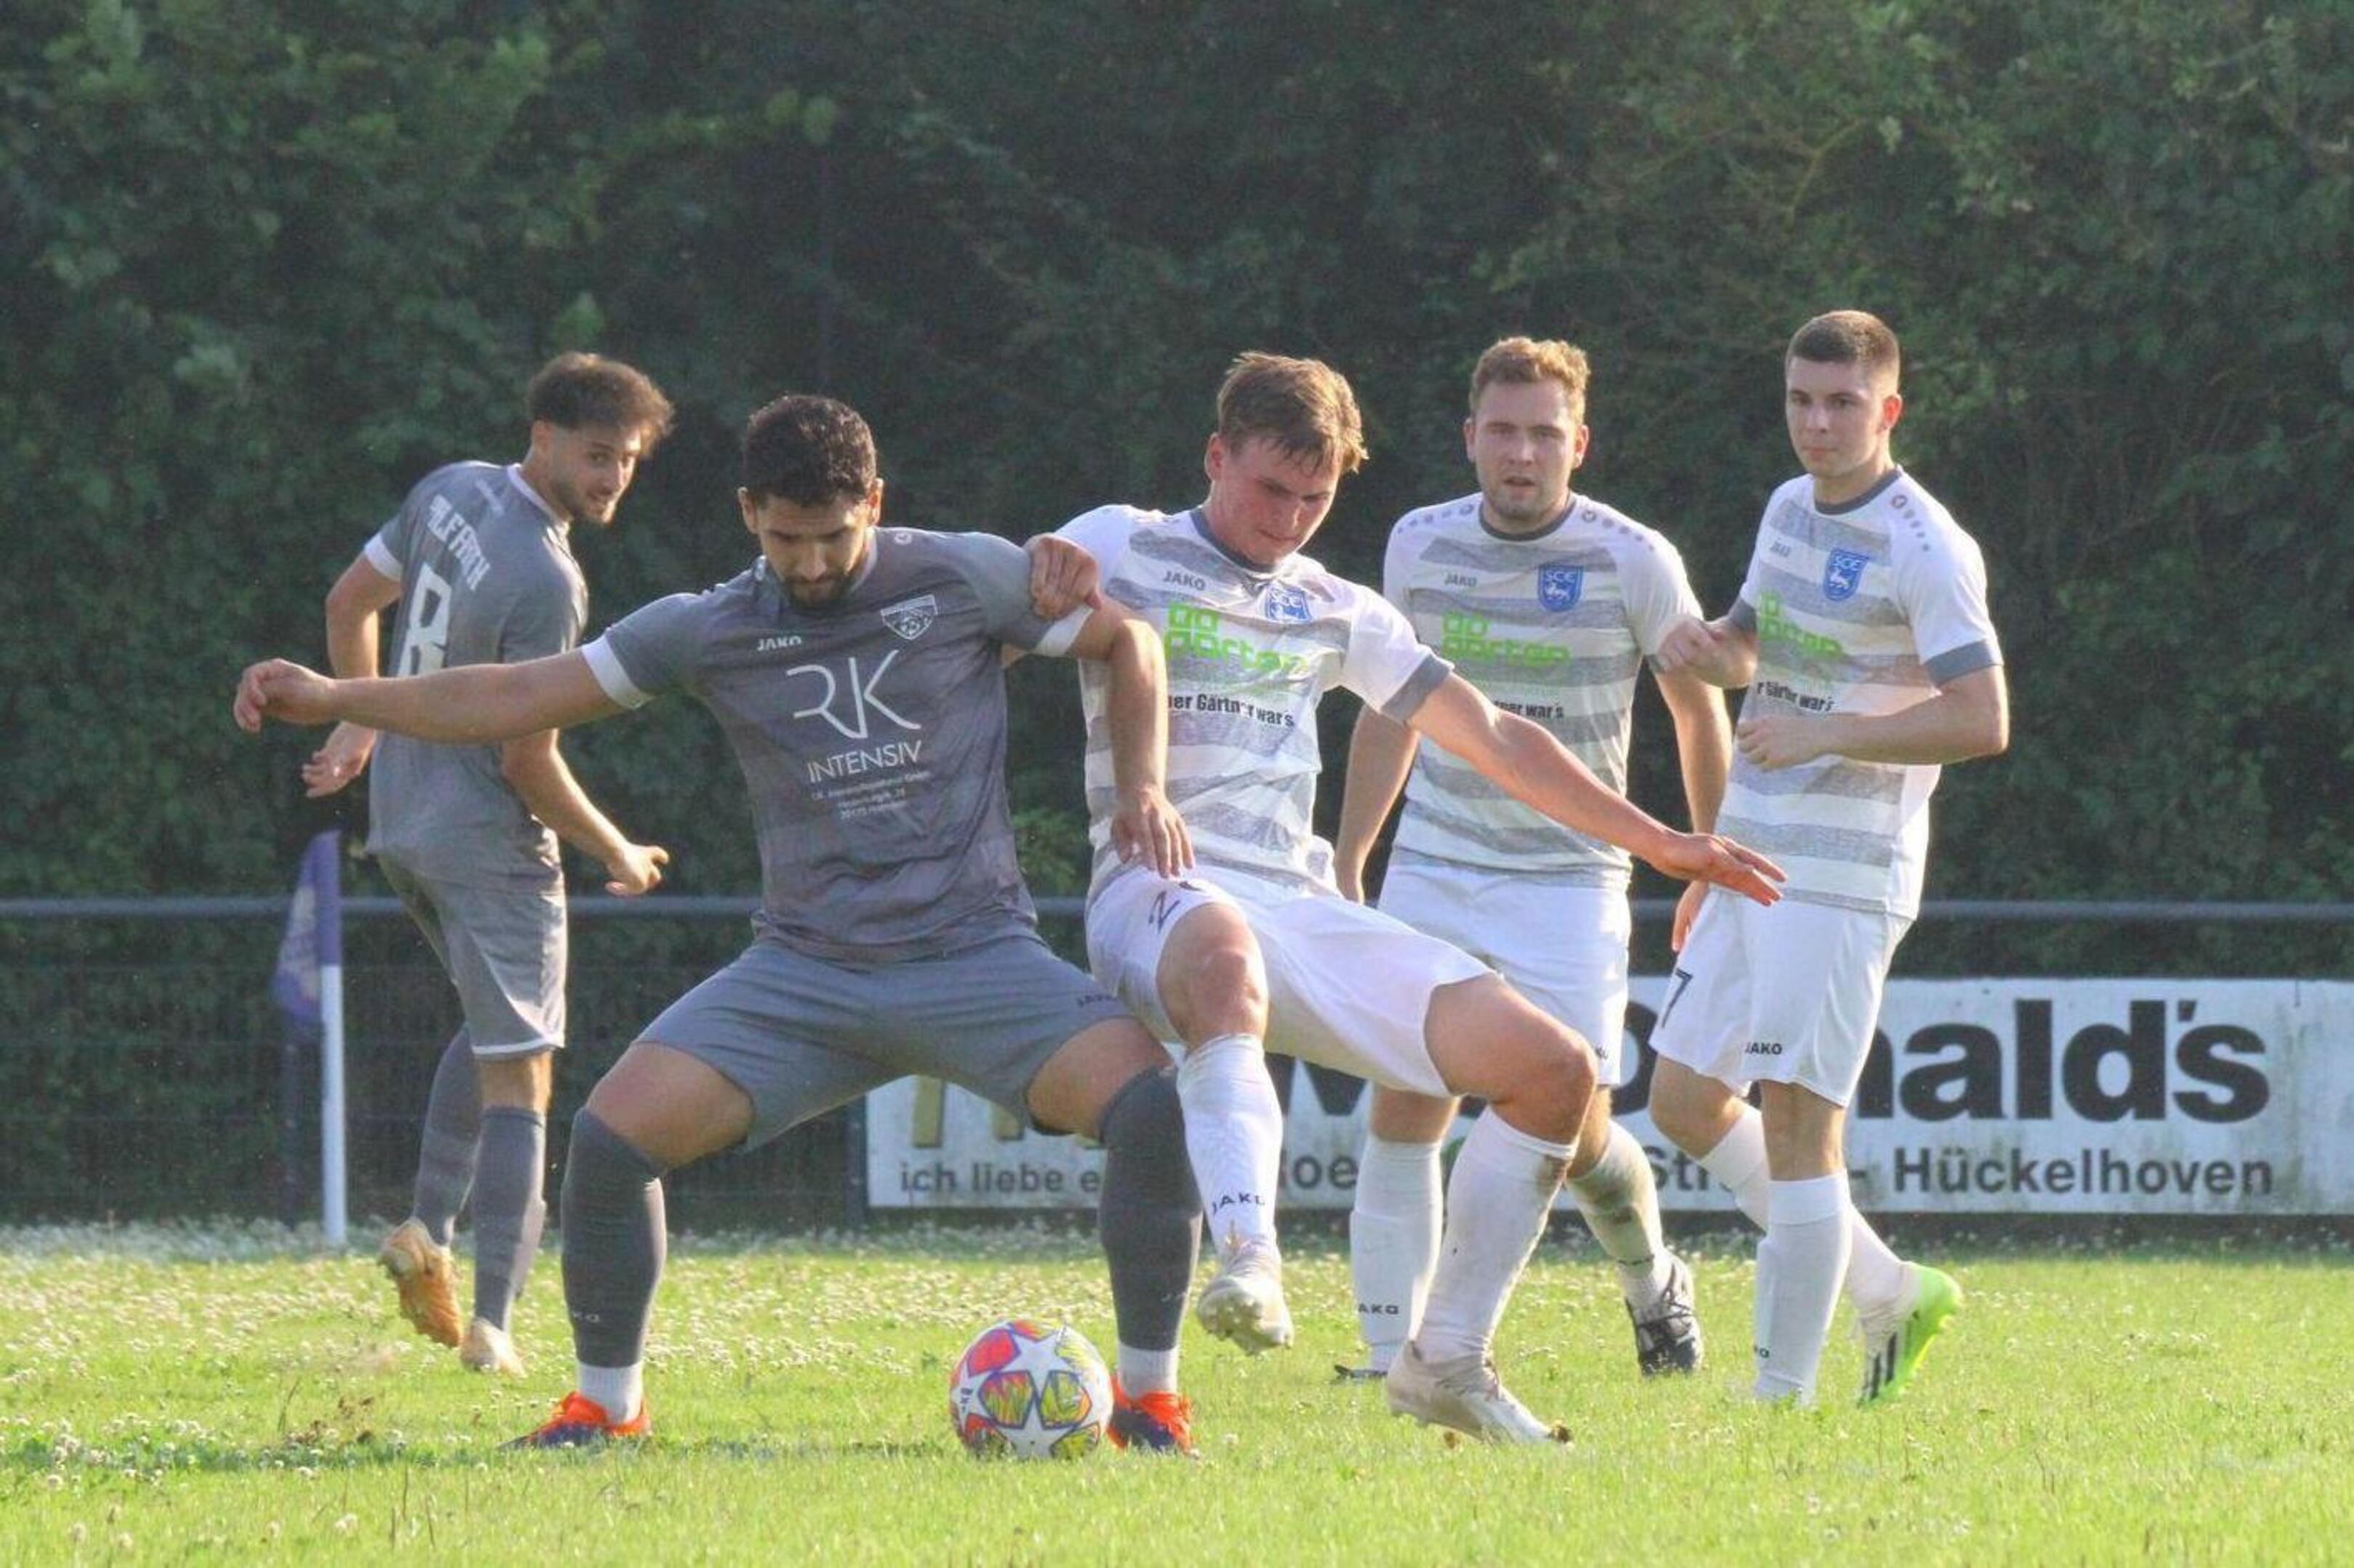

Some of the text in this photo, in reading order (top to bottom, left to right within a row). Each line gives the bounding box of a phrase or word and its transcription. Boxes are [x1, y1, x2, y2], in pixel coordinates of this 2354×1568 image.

[1162, 570, 1206, 591] JAKO
[756, 635, 802, 652] JAKO
[807, 740, 922, 783] INTENSIV
[1661, 967, 1694, 1029] 7
[1745, 1042, 1783, 1055] JAKO
[900, 1163, 1101, 1192] ich liebe e
[1893, 1147, 2273, 1195] Hückelhoven
[1358, 1303, 1399, 1315] AKO
